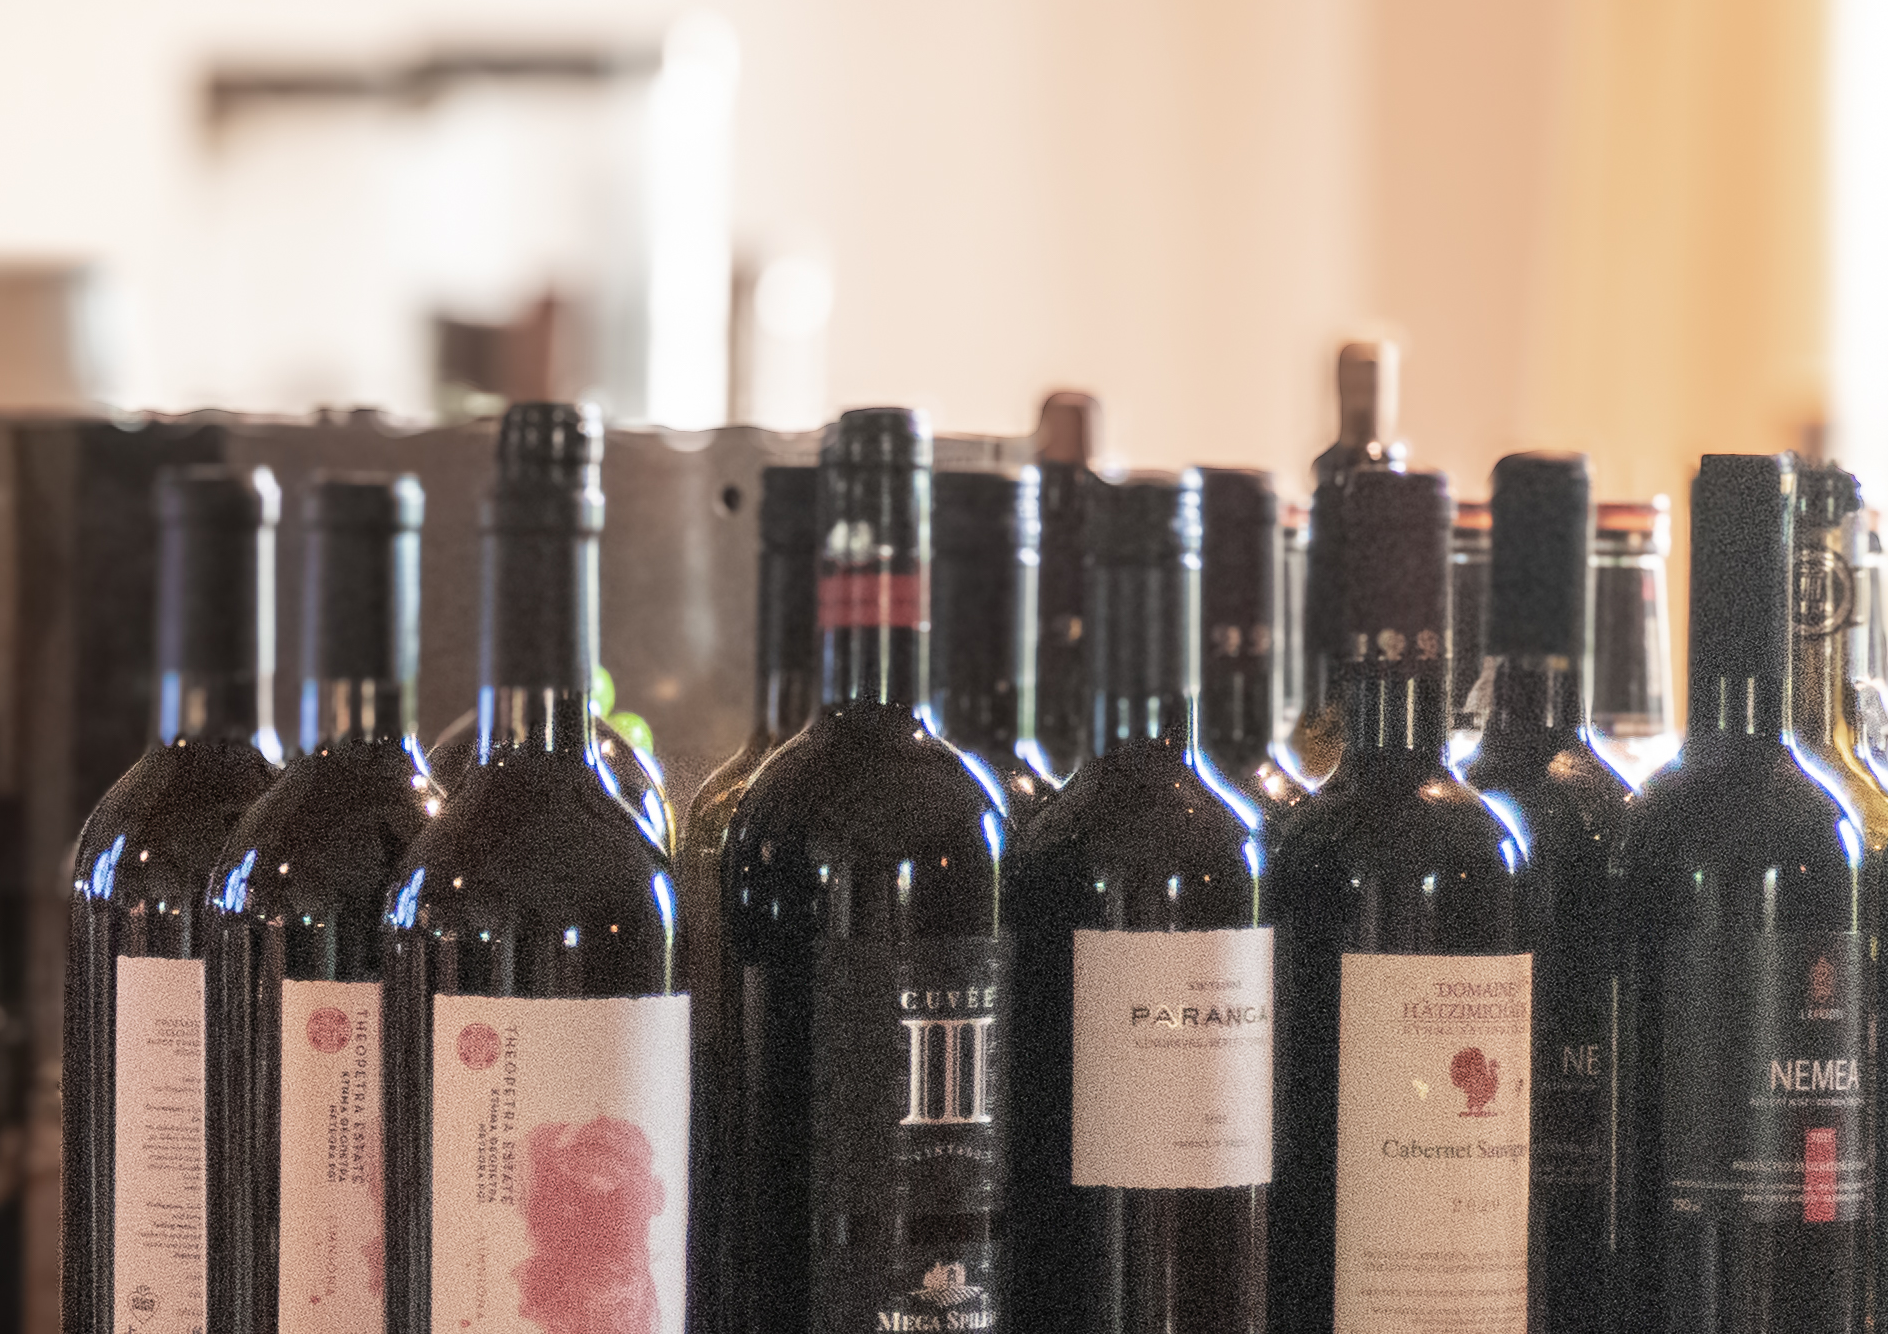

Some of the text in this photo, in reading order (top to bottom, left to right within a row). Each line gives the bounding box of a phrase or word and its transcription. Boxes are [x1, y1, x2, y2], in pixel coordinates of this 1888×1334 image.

[1131, 1006, 1268, 1027] PARANGA
[1770, 1059, 1860, 1091] NEMEA
[352, 1009, 369, 1185] THEOPETRA ESTATE
[501, 1025, 517, 1207] THEOPETRA ESTATE
[1382, 1139, 1472, 1159] Cabernet
[876, 1311, 940, 1332] MEGA
